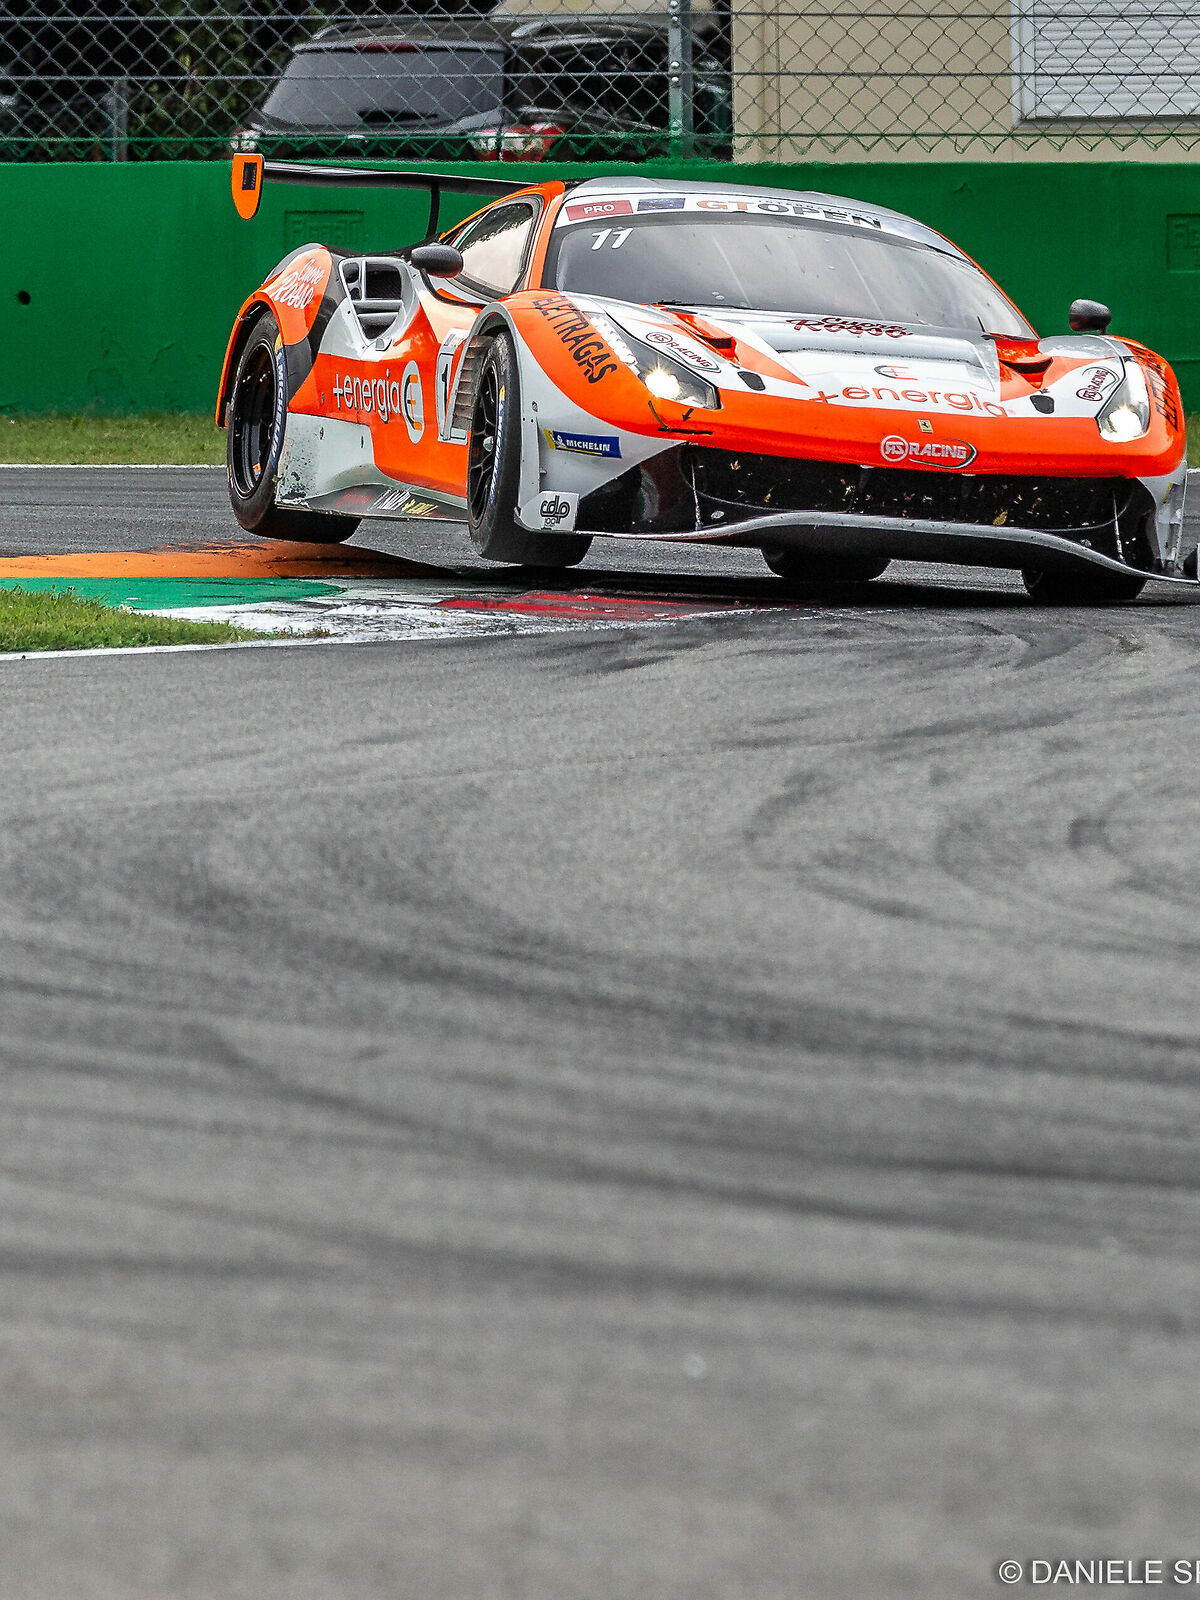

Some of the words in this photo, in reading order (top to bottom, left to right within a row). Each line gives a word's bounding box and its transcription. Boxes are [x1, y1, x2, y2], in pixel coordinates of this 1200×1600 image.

[584, 203, 615, 215] PRO
[696, 200, 754, 211] GT
[757, 203, 881, 229] OPEN
[591, 227, 634, 251] 11
[532, 295, 618, 384] ELETTRAGAS
[785, 319, 913, 339] Rosso
[668, 338, 713, 369] RACING
[565, 439, 611, 452] MICHELIN
[908, 441, 968, 460] RACING
